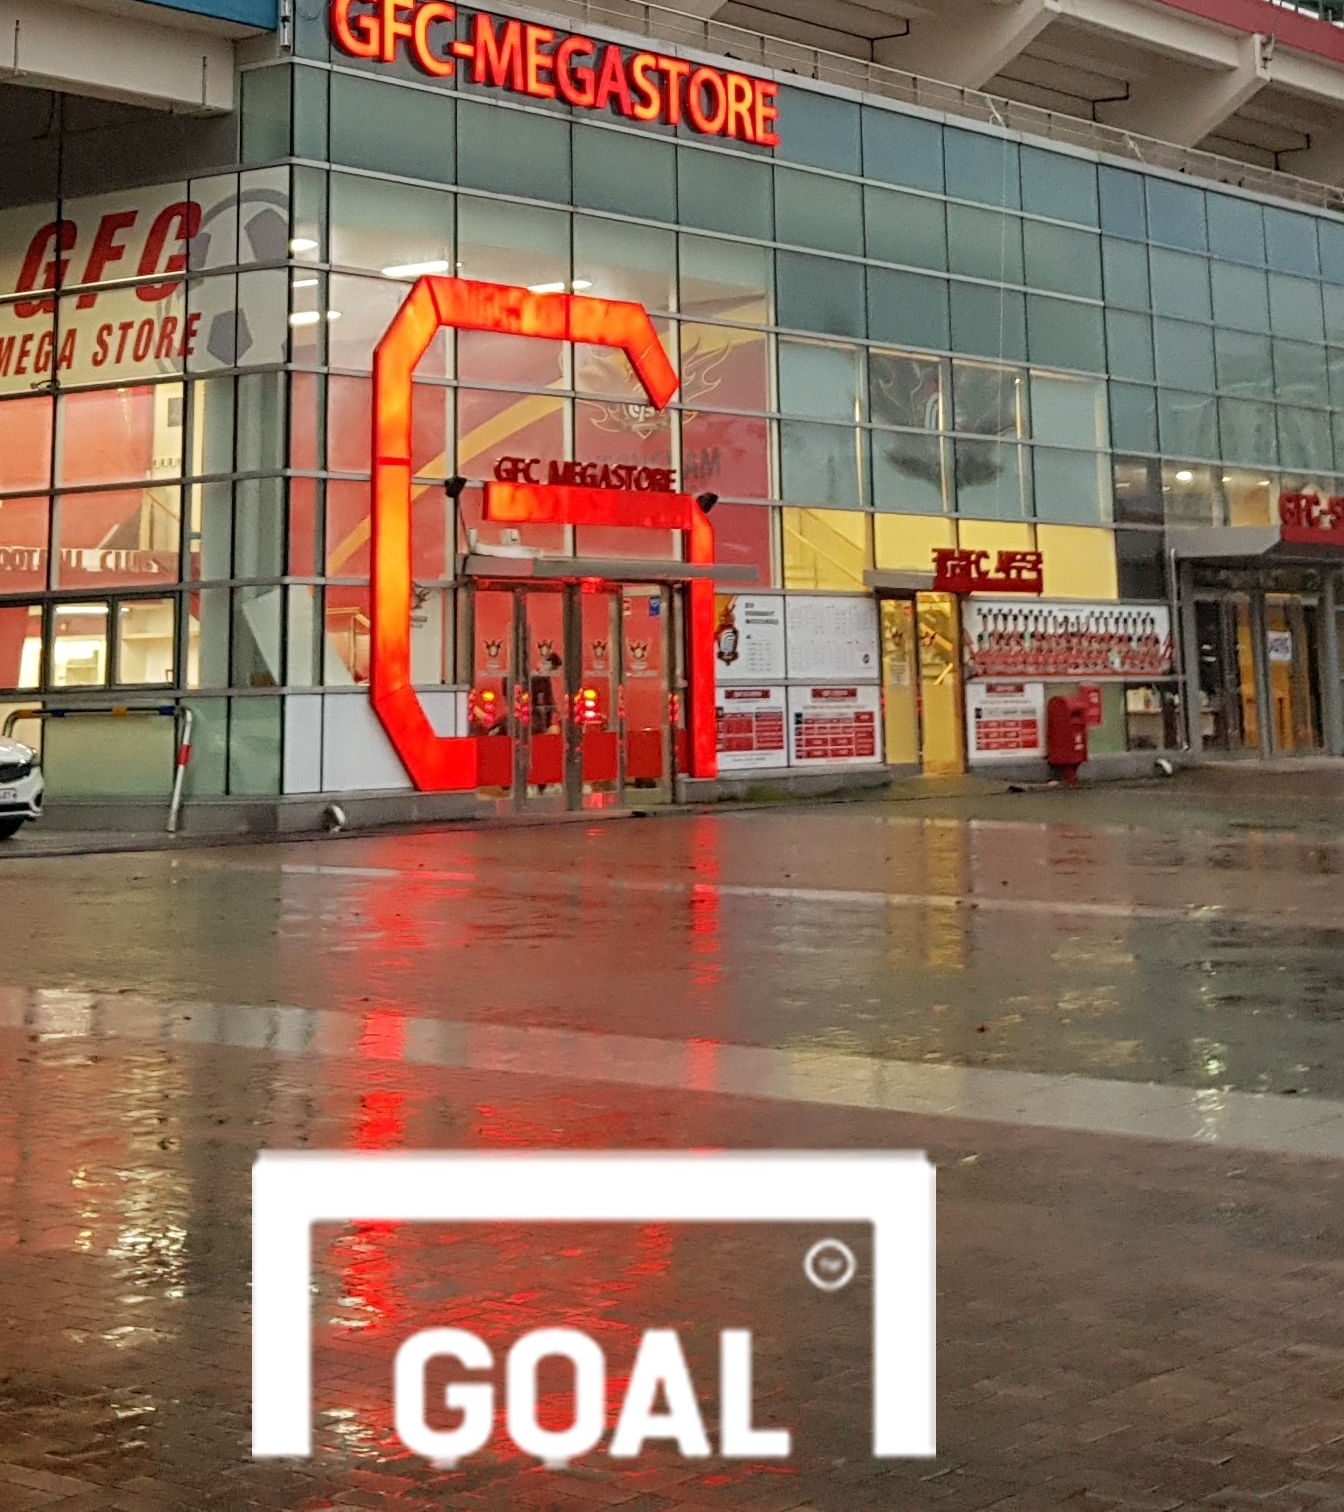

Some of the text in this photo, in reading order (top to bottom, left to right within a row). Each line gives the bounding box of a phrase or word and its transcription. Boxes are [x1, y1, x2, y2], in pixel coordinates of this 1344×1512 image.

[13, 201, 202, 319] GFC
[91, 312, 202, 368] STORE
[493, 456, 541, 485] GFC
[547, 459, 677, 494] MEGASTORE
